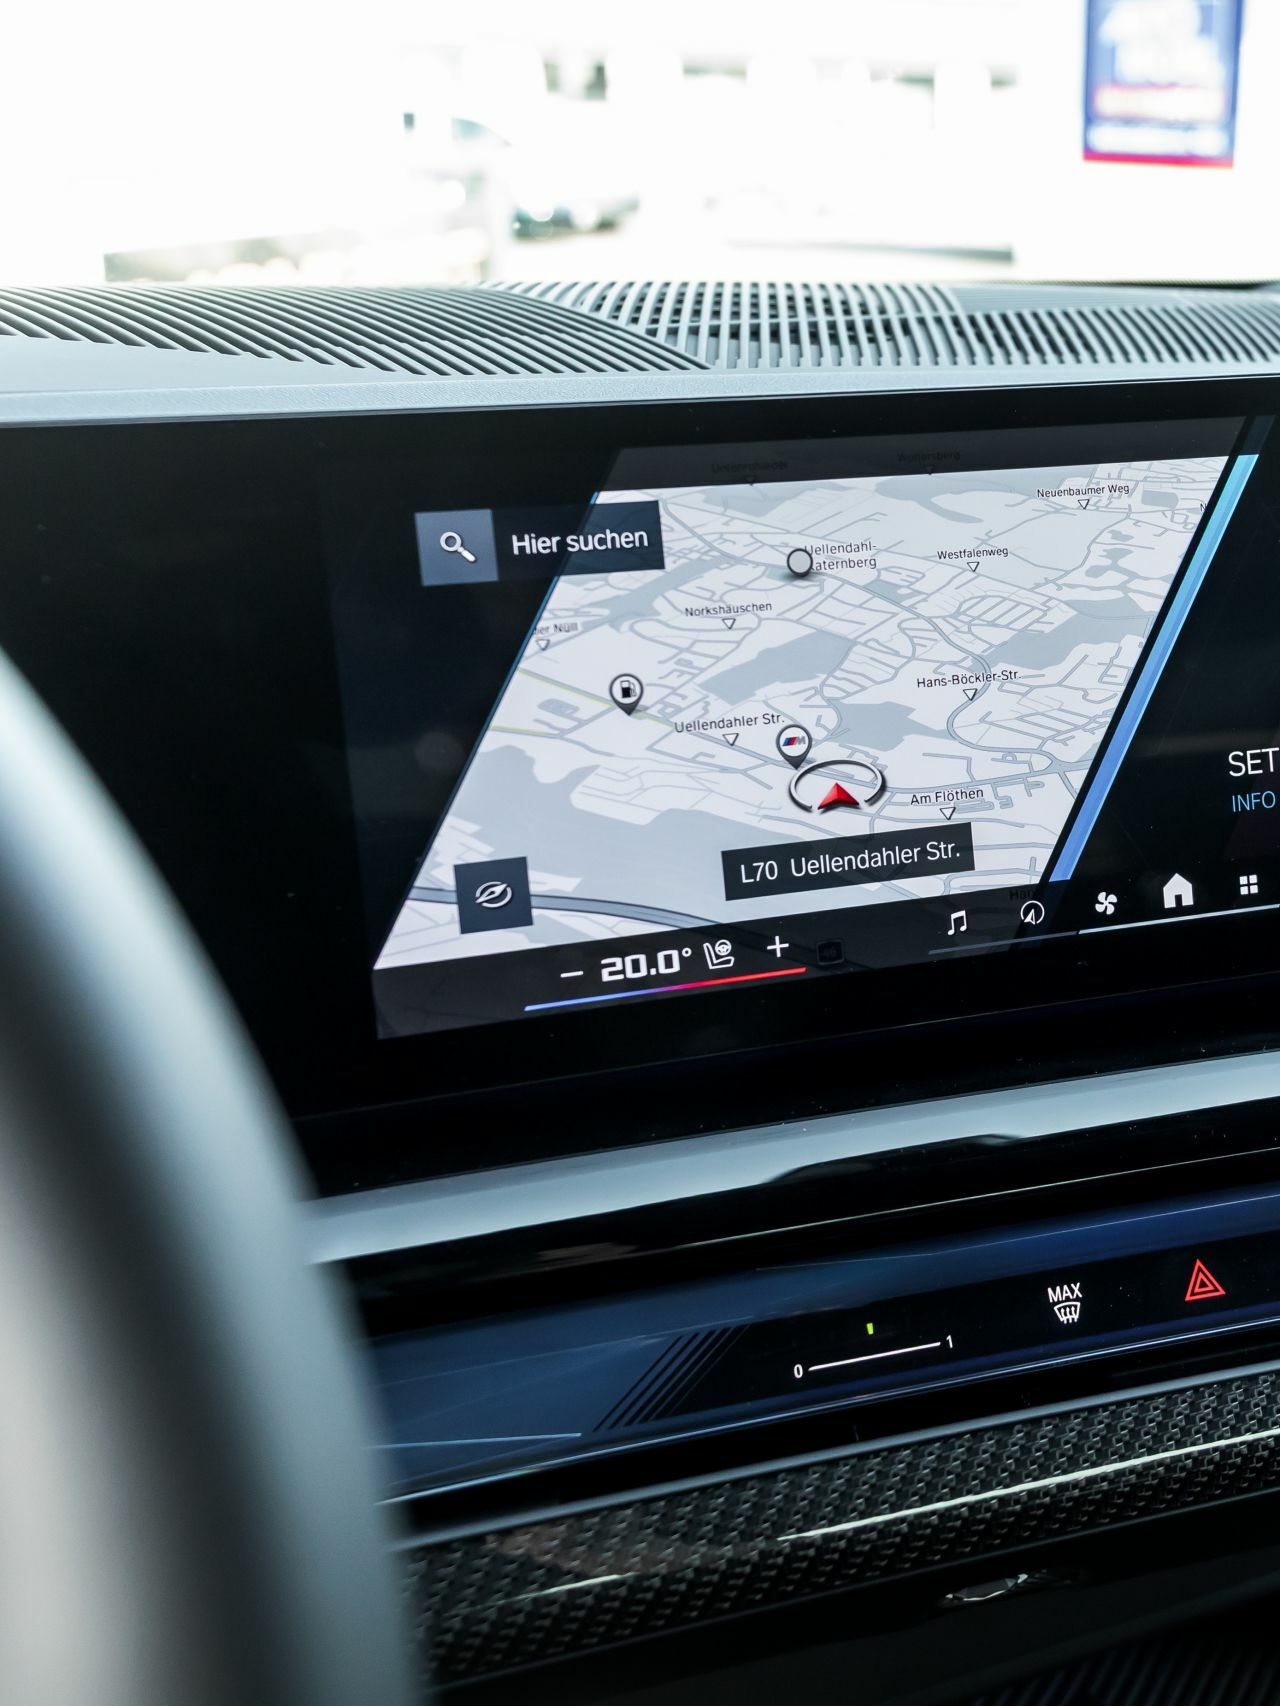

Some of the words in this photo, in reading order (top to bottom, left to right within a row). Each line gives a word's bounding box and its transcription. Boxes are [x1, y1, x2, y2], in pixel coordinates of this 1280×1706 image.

[1037, 487, 1105, 498] Neuenbaumer
[1108, 485, 1130, 498] Weg
[511, 534, 560, 556] Hier
[566, 529, 648, 552] suchen
[937, 547, 1009, 561] Westfalenweg
[810, 557, 877, 571] aternberg
[684, 602, 772, 617] Norkshäuschen
[916, 670, 1022, 689] Hans-Böckler-Str.
[674, 717, 758, 733] Uellendahler
[761, 714, 785, 728] Str.
[910, 793, 930, 806] Am
[934, 787, 984, 803] Flöthen
[1231, 790, 1277, 813] INFO
[740, 861, 779, 884] L70
[790, 846, 922, 878] Uellendahler
[926, 841, 961, 863] Str.
[601, 947, 692, 981] 20.0°
[1046, 1283, 1083, 1303] MAX
[793, 1364, 803, 1379] 0
